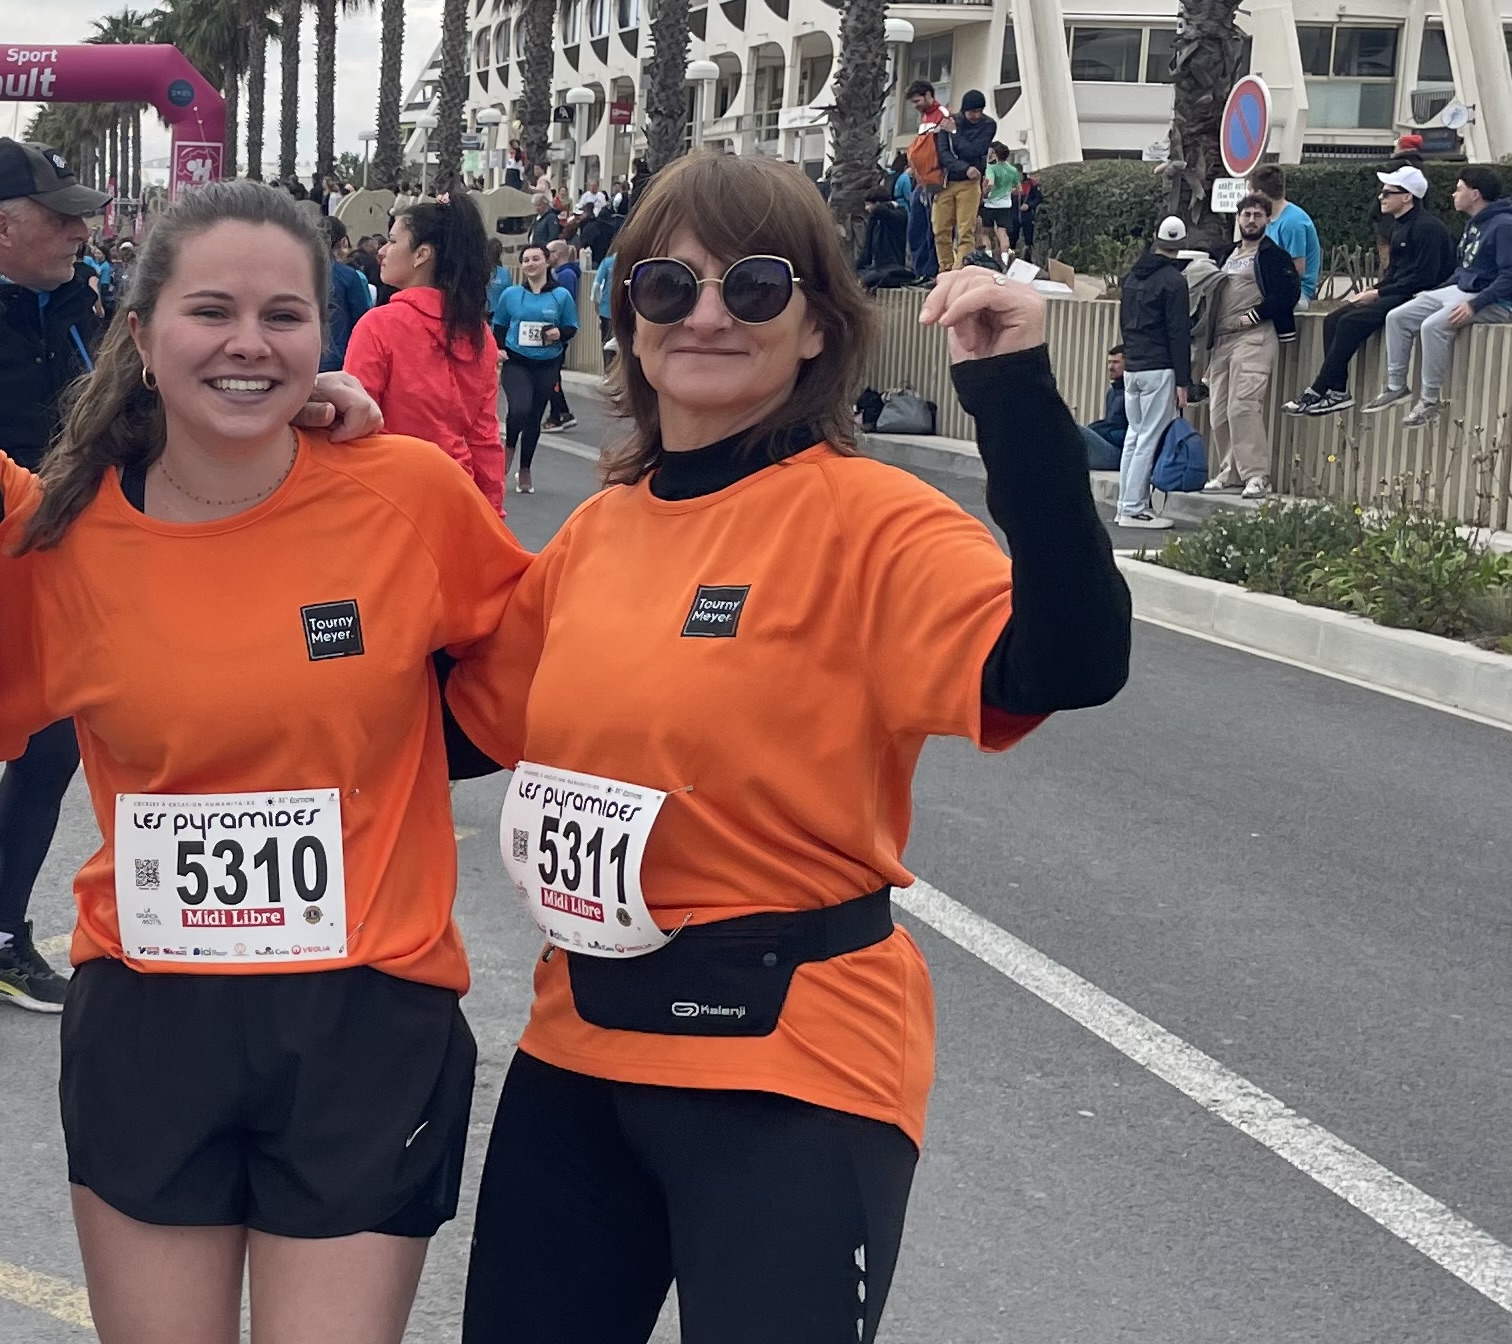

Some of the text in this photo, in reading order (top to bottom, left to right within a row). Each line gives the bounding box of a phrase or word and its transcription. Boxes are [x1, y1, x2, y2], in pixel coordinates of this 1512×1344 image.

[6, 48, 58, 65] Sport
[528, 328, 542, 339] 52
[698, 598, 741, 611] Tourny
[309, 616, 354, 631] Tourny
[518, 780, 541, 800] LES
[133, 811, 167, 830] LES
[538, 815, 631, 905] 5311
[176, 835, 328, 905] 5310
[543, 890, 603, 920] Midi Libre
[185, 908, 281, 926] Midi Libre
[700, 1004, 746, 1019] Kalenji
